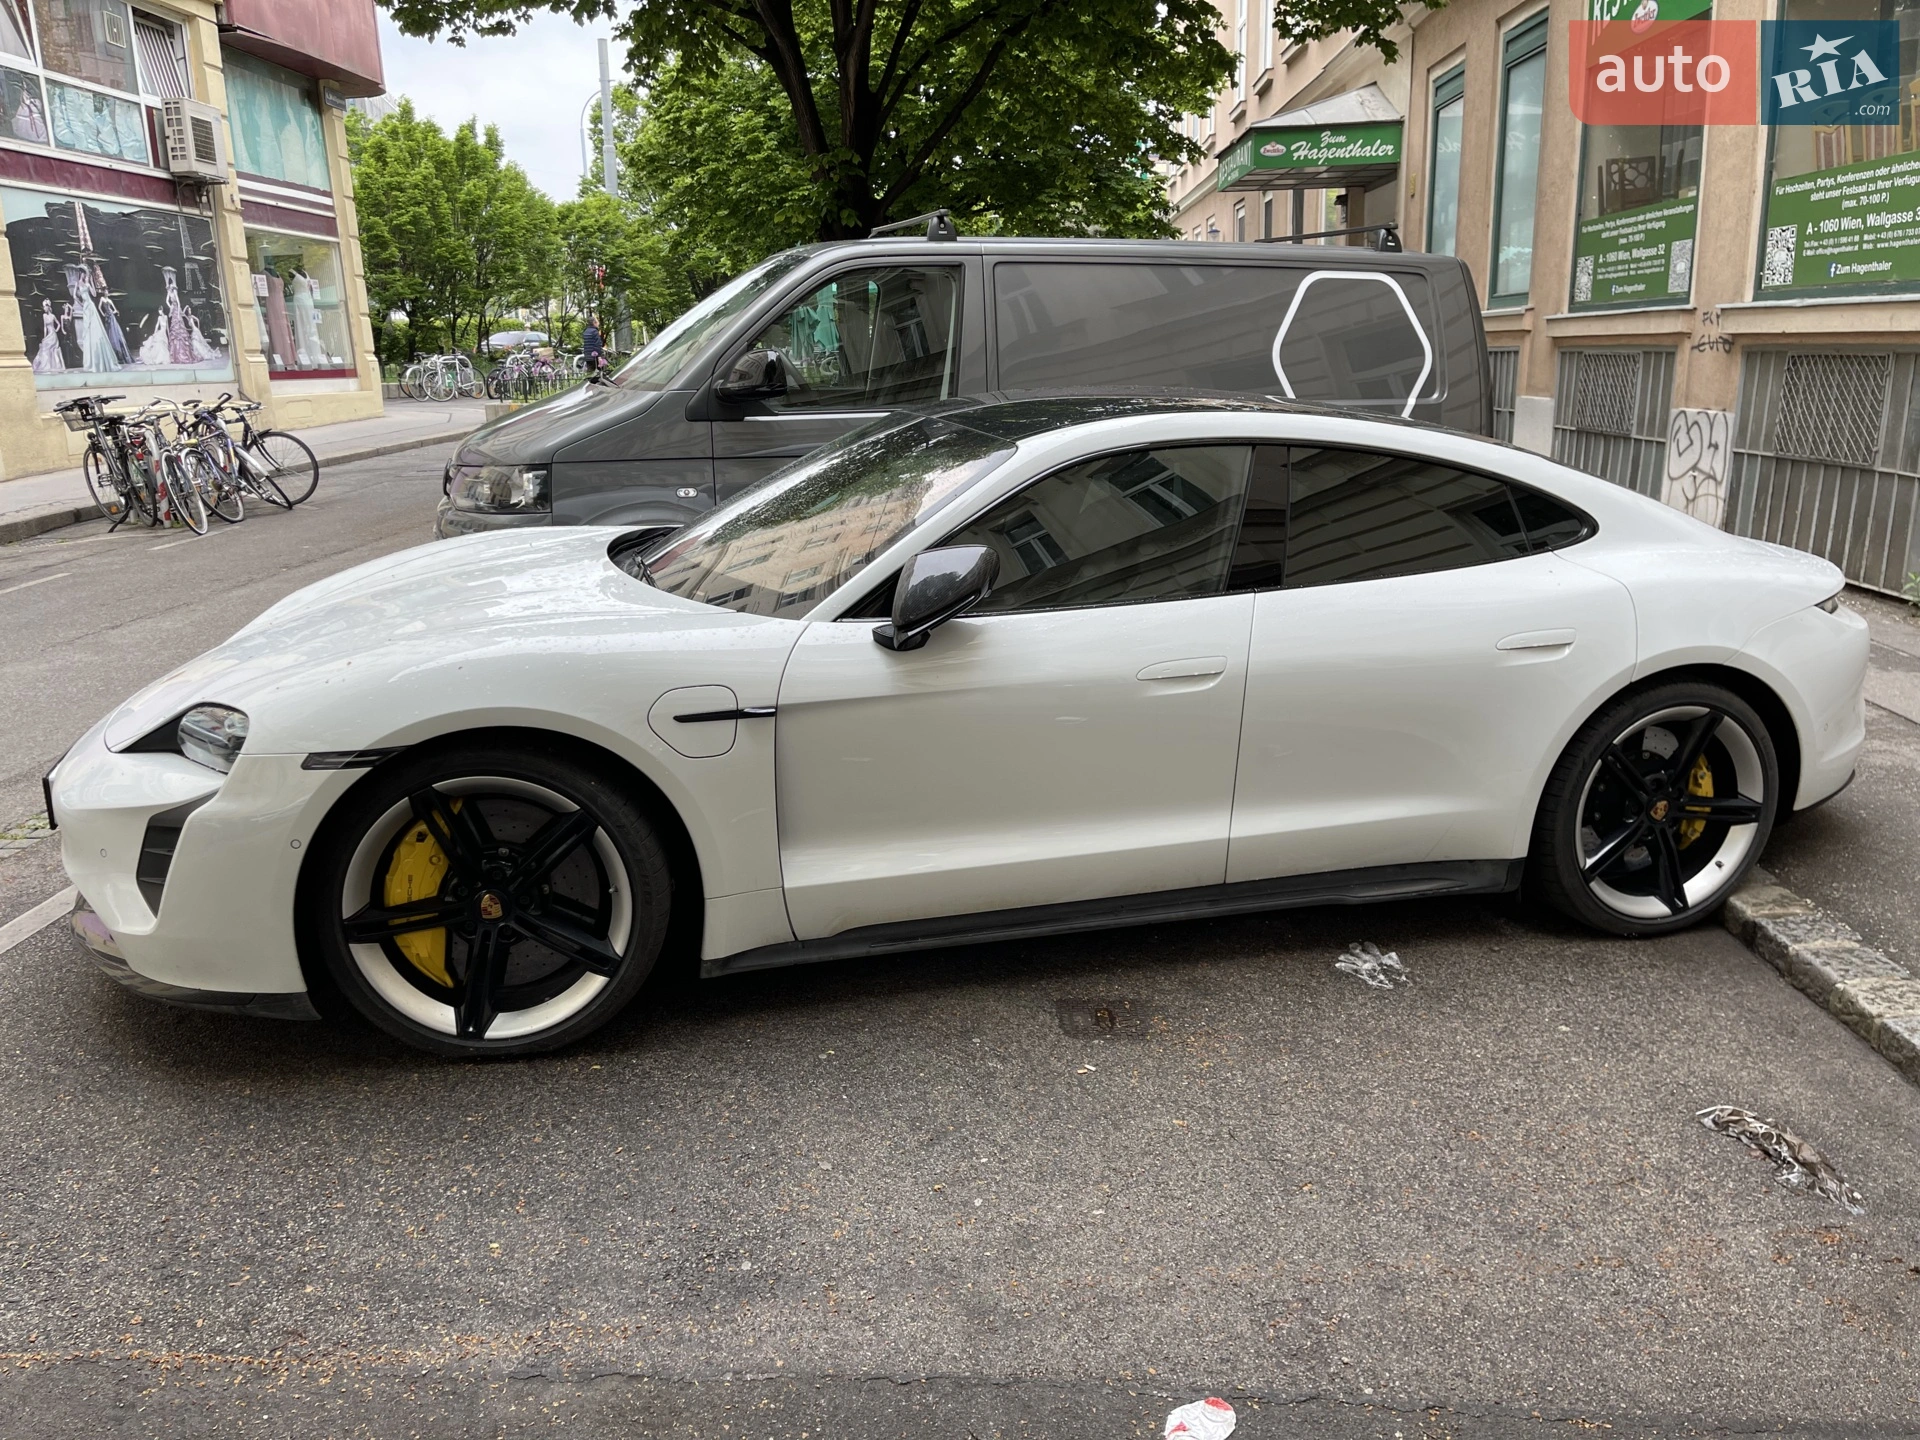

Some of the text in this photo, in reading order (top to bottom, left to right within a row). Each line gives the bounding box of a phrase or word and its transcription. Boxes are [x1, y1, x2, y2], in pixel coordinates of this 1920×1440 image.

[1320, 131, 1347, 147] Zum
[1290, 139, 1394, 165] Hagenthaler
[1816, 177, 1836, 188] Partys,
[1836, 170, 1875, 184] Konferenzen
[1875, 166, 1891, 177] oder
[1810, 190, 1825, 202] steht
[1825, 189, 1842, 199] unser
[1842, 182, 1868, 196] Festsaal
[1868, 182, 1876, 191] zu
[1876, 180, 1893, 190] Ihrer
[1860, 193, 1881, 206] 70-100
[1881, 192, 1890, 204] P.)
[1806, 222, 1813, 235] A
[1819, 218, 1839, 234] 1060
[1840, 216, 1864, 231] Wien,
[1866, 211, 1914, 229] Wallgasse
[1836, 264, 1851, 275] Zum
[1851, 260, 1893, 275] Hagenthaler
